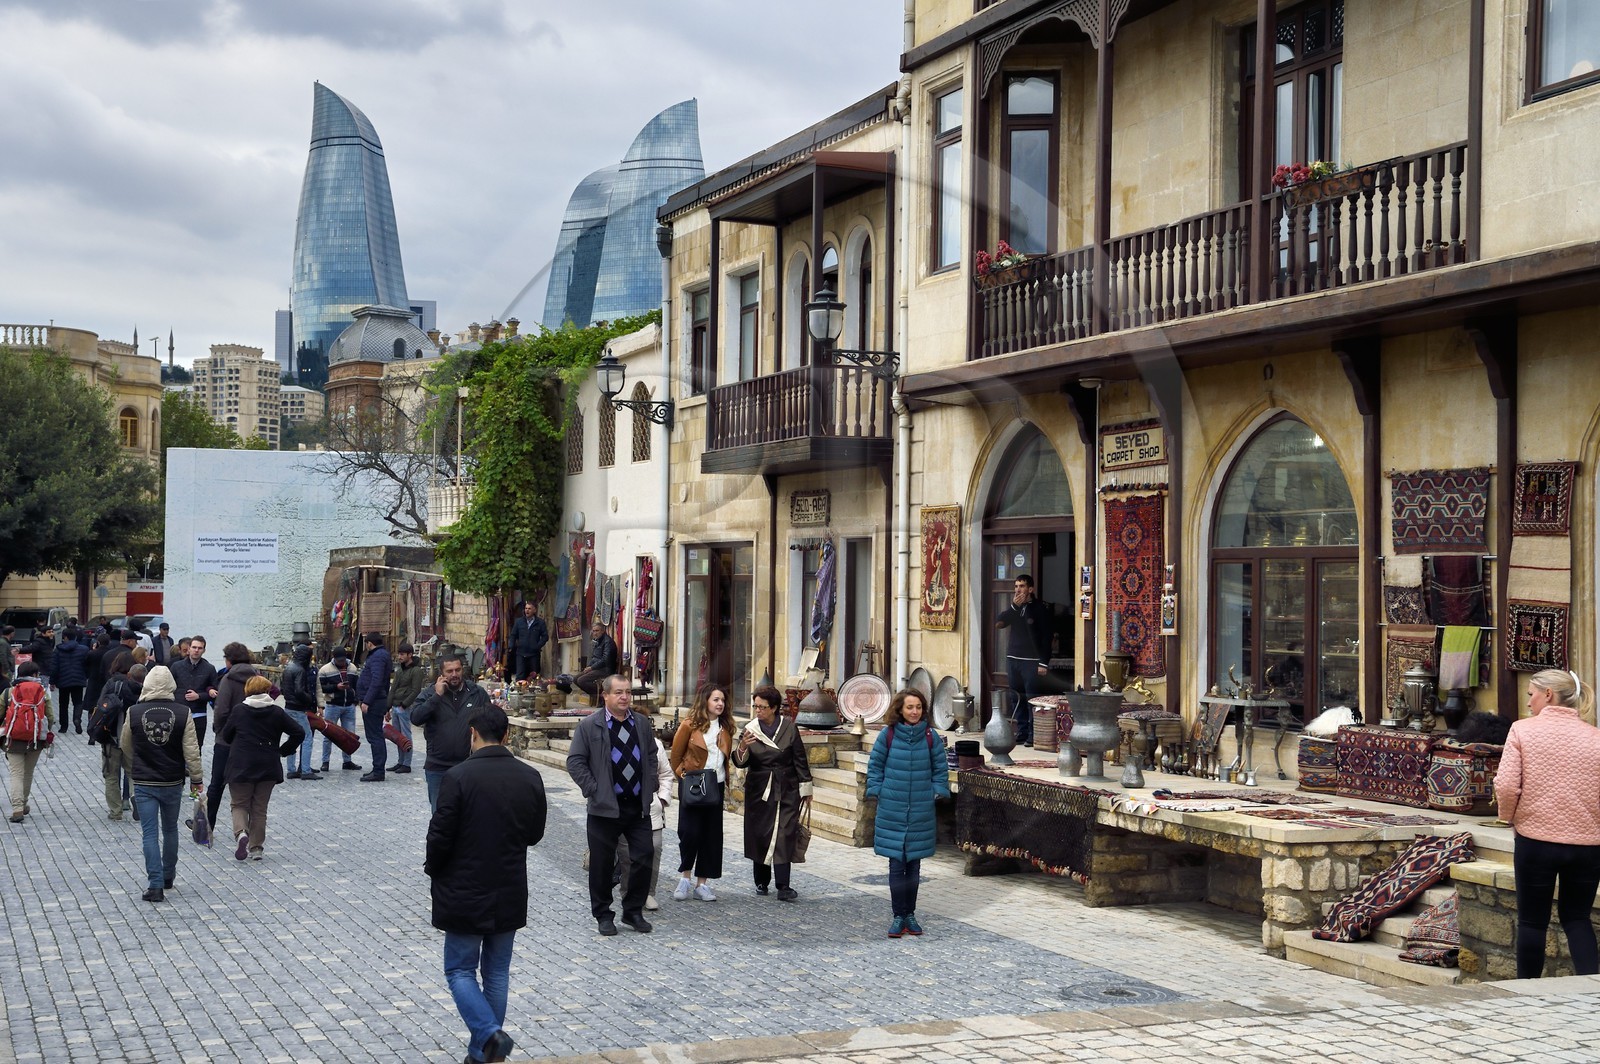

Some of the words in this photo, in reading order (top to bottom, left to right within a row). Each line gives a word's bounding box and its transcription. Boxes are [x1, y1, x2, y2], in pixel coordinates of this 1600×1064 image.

[1115, 432, 1150, 450] SEYED
[1106, 449, 1134, 464] CARPET
[1139, 445, 1160, 459] SHOP
[793, 513, 813, 522] CARPET
[813, 511, 826, 521] SHOP
